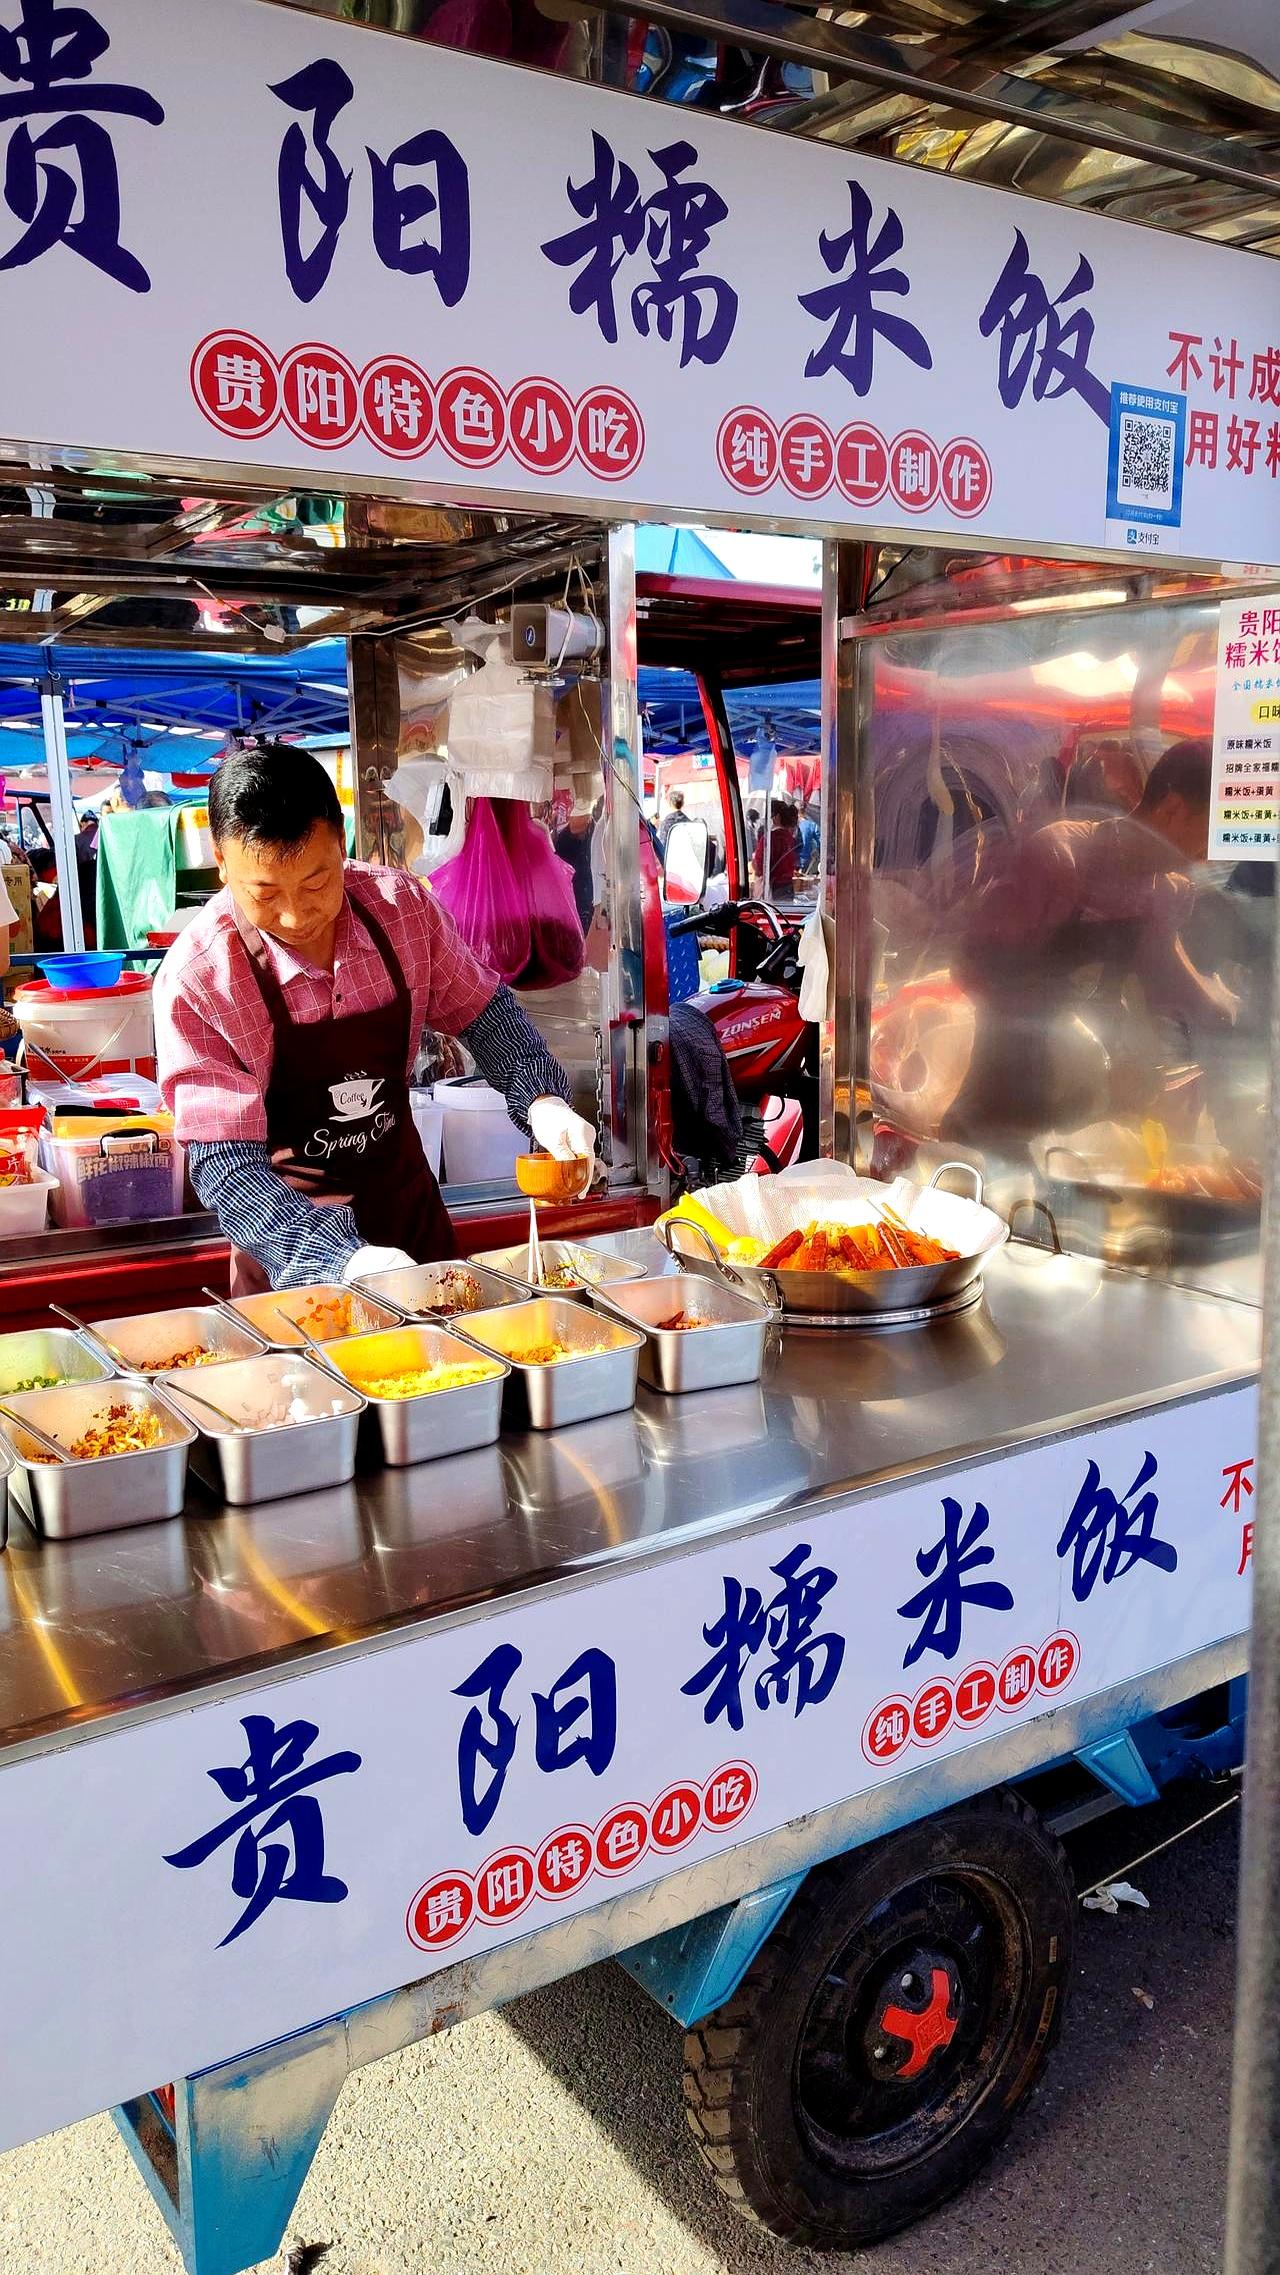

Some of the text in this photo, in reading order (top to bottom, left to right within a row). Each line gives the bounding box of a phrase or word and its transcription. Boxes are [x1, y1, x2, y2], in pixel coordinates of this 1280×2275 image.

[0, 0, 1110, 427] 贵阳糯米饭
[1166, 331, 1280, 408] 不计成
[213, 352, 631, 462] 贵阳特色小吃
[1120, 391, 1179, 414] 推荐使用支付宝
[731, 422, 981, 503] 纯手工制作
[1227, 738, 1272, 750] 原味糯米饭
[1225, 785, 1273, 797] 糯米饭+蛋黄
[1224, 809, 1280, 820] 糯米饭+蛋黄+
[1222, 832, 1280, 844] 糯米饭+蛋黄+
[721, 1009, 781, 1039] ZONSEN
[340, 1091, 367, 1107] Coffee
[304, 1128, 368, 1158] Spring
[163, 1450, 1177, 1949] 贵阳糯米饭
[875, 1646, 1069, 1752] 纯手工制作
[425, 1769, 746, 1937] 贵阳特色小吃
